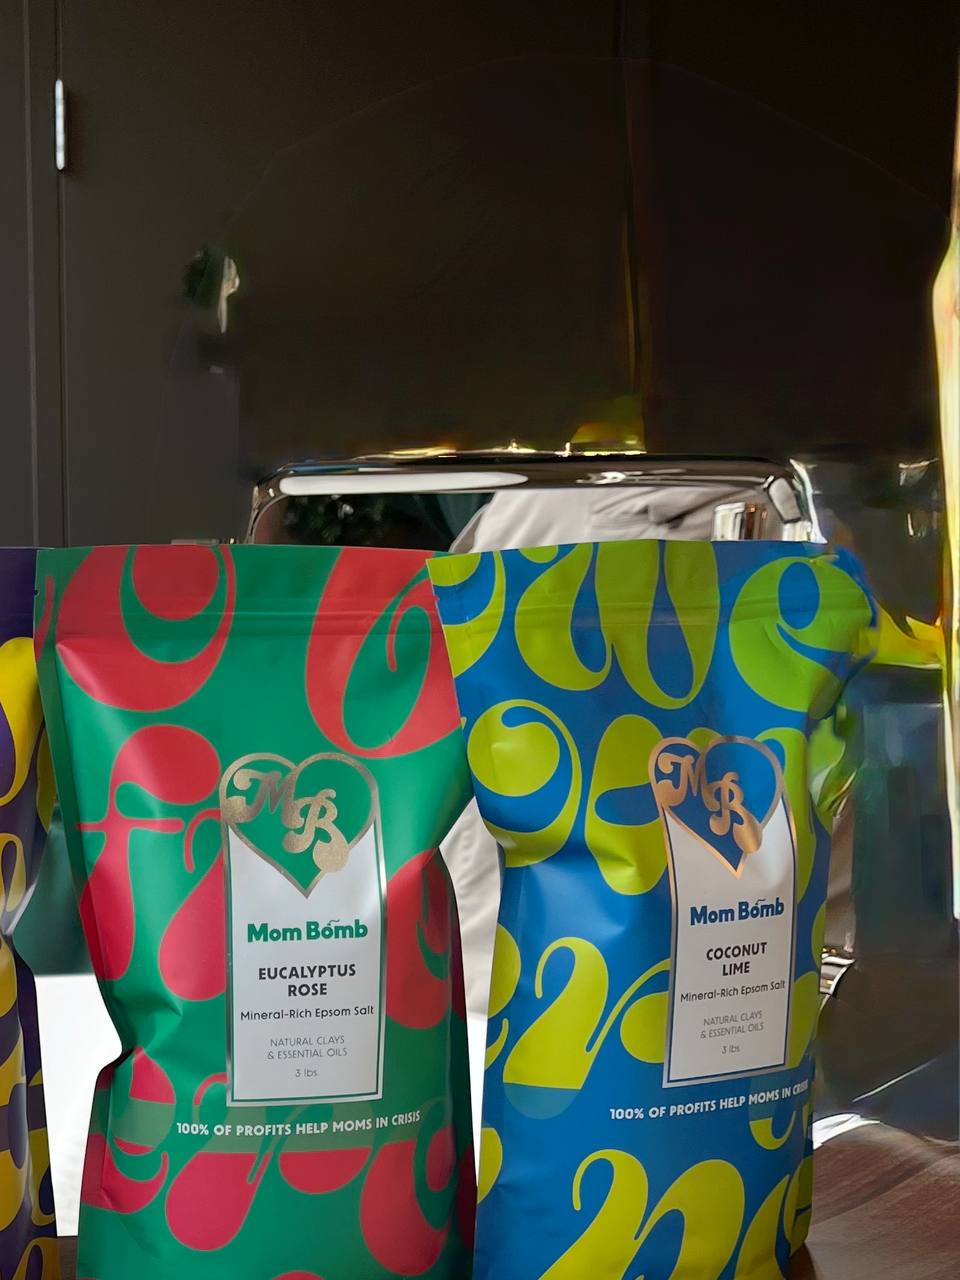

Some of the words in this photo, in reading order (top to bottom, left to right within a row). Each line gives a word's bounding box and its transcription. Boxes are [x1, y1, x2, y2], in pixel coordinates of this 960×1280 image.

[690, 906, 735, 926] Mom
[247, 923, 302, 943] Mom
[706, 942, 768, 961] COCONUT
[258, 964, 356, 980] EUCALYPTUS
[722, 961, 750, 977] LIME
[288, 983, 327, 997] ROSE
[680, 986, 739, 1003] Mineral-Rich
[741, 984, 769, 997] Epsom
[770, 980, 785, 991] Salt
[240, 1008, 312, 1021] Mineral-Rich
[315, 1007, 351, 1019] Epsom
[354, 1005, 374, 1015] Salt
[703, 1015, 738, 1027] NATURAL
[740, 1011, 763, 1022] CLAYS
[700, 1030, 707, 1039] &
[709, 1025, 746, 1038] ESSENTIAL
[748, 1022, 764, 1033] OILS
[270, 1037, 313, 1047] NATURAL
[316, 1035, 345, 1045] CLAYS
[267, 1051, 274, 1060] &
[277, 1049, 324, 1059] ESSENTIAL
[327, 1048, 348, 1058] OILS
[722, 1046, 727, 1054] 3
[295, 1069, 301, 1077] 3
[609, 1107, 644, 1120] 100%
[648, 1106, 666, 1118] OF
[669, 1100, 716, 1116] PROFITS
[719, 1095, 745, 1110] HELP
[748, 1088, 780, 1105] MOMS
[782, 1087, 791, 1098] IN
[176, 1122, 209, 1135] 100%
[213, 1124, 232, 1136] OF
[236, 1123, 292, 1136] PROFITS
[296, 1122, 328, 1134] HELP
[333, 1118, 372, 1133] MOMS
[375, 1117, 388, 1128] IN
[391, 1110, 421, 1126] CRISIS
